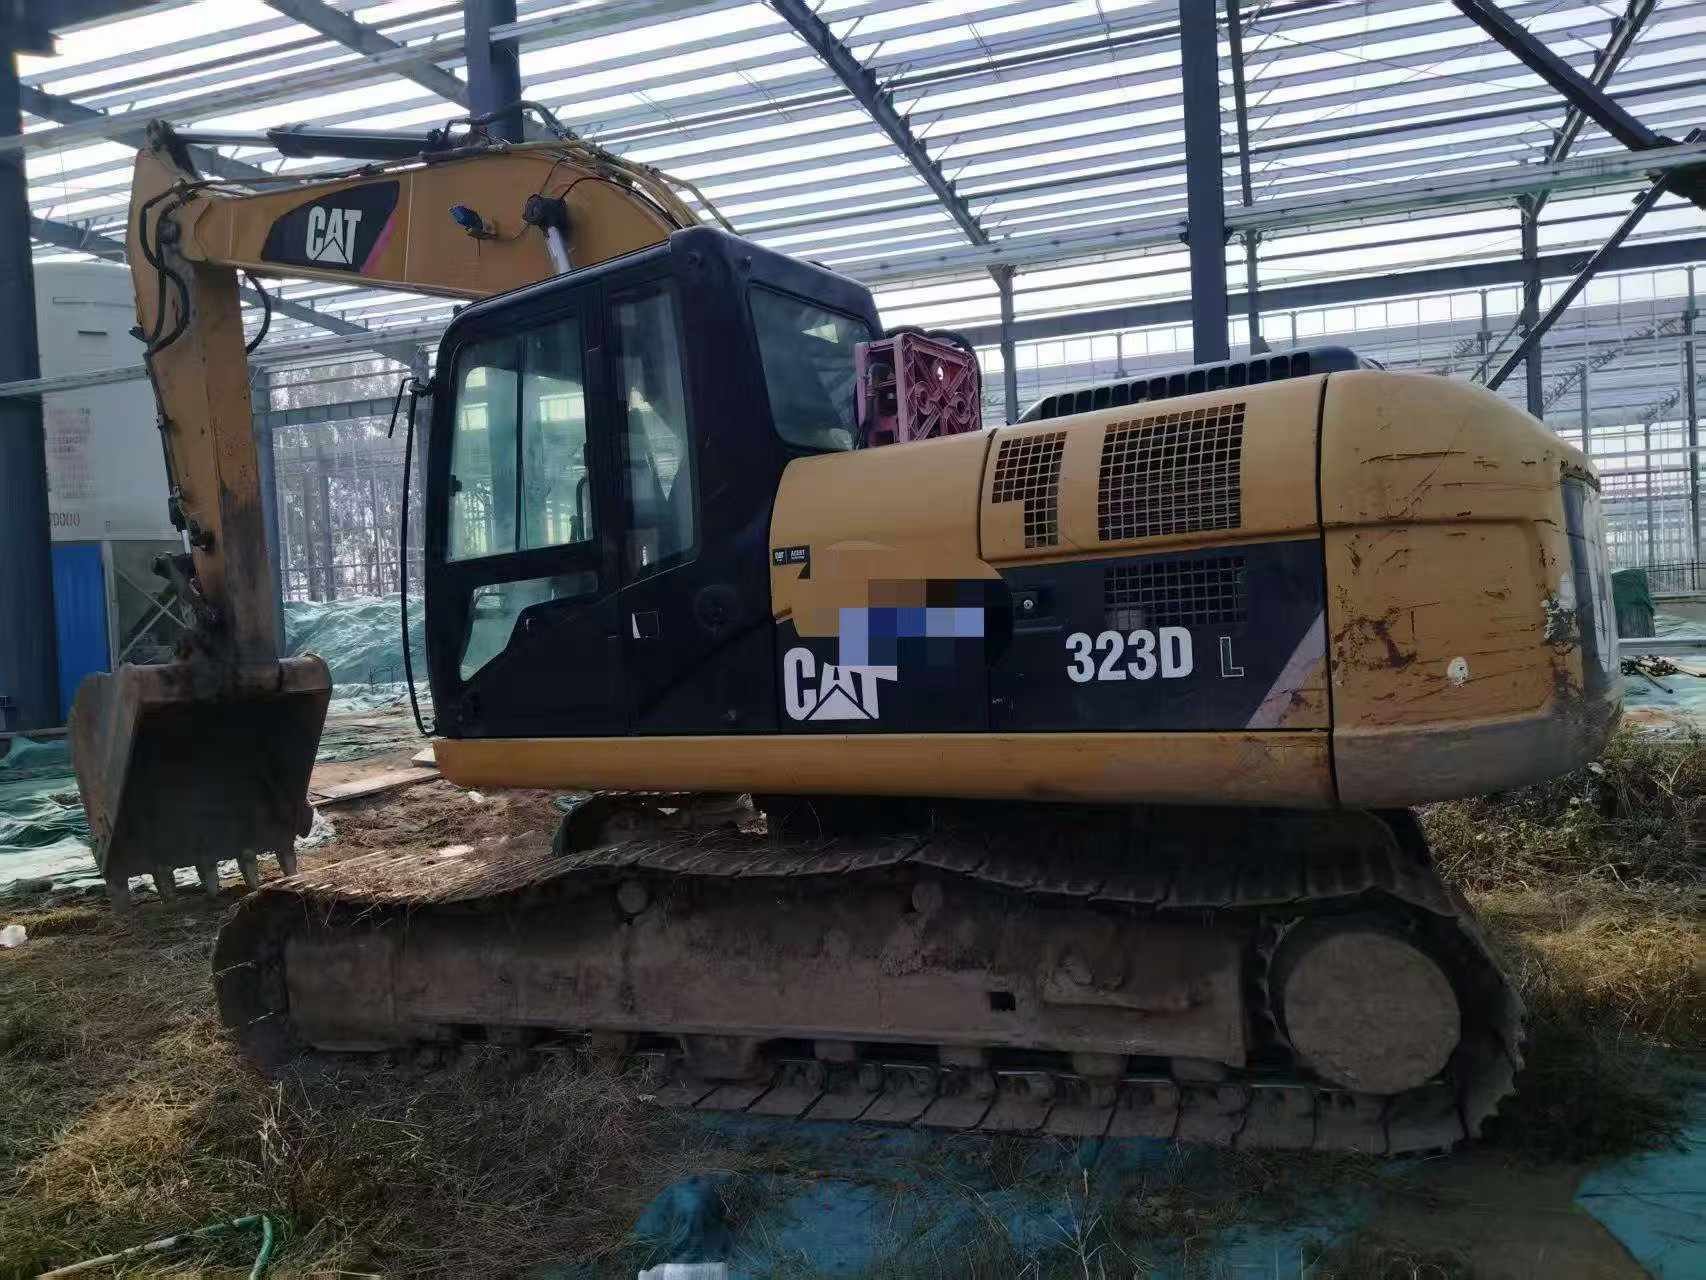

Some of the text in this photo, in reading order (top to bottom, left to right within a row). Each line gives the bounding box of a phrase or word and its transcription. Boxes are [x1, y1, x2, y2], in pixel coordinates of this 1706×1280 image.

[305, 205, 363, 265] CAT
[783, 646, 898, 720] CAT
[1065, 626, 1245, 683] 323D L
